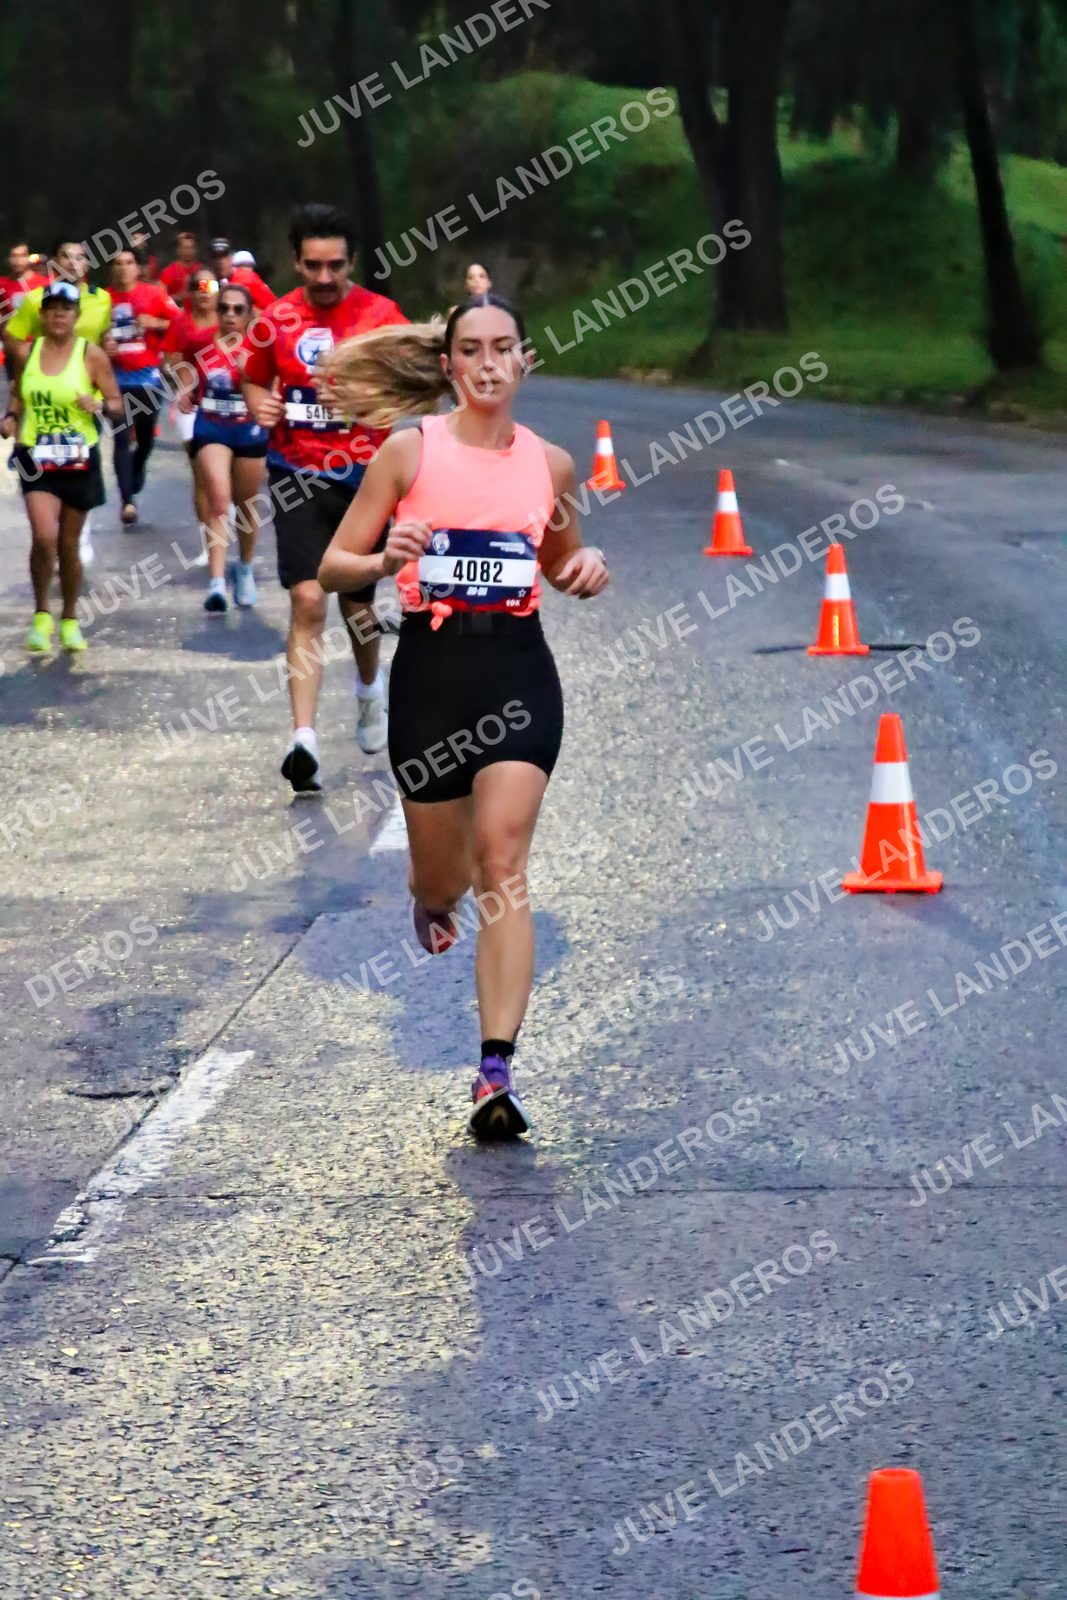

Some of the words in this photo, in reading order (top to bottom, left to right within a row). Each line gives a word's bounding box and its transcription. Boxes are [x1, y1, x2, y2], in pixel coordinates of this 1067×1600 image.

[31, 390, 51, 406] IN
[33, 407, 69, 423] TEN
[453, 559, 503, 583] 4082
